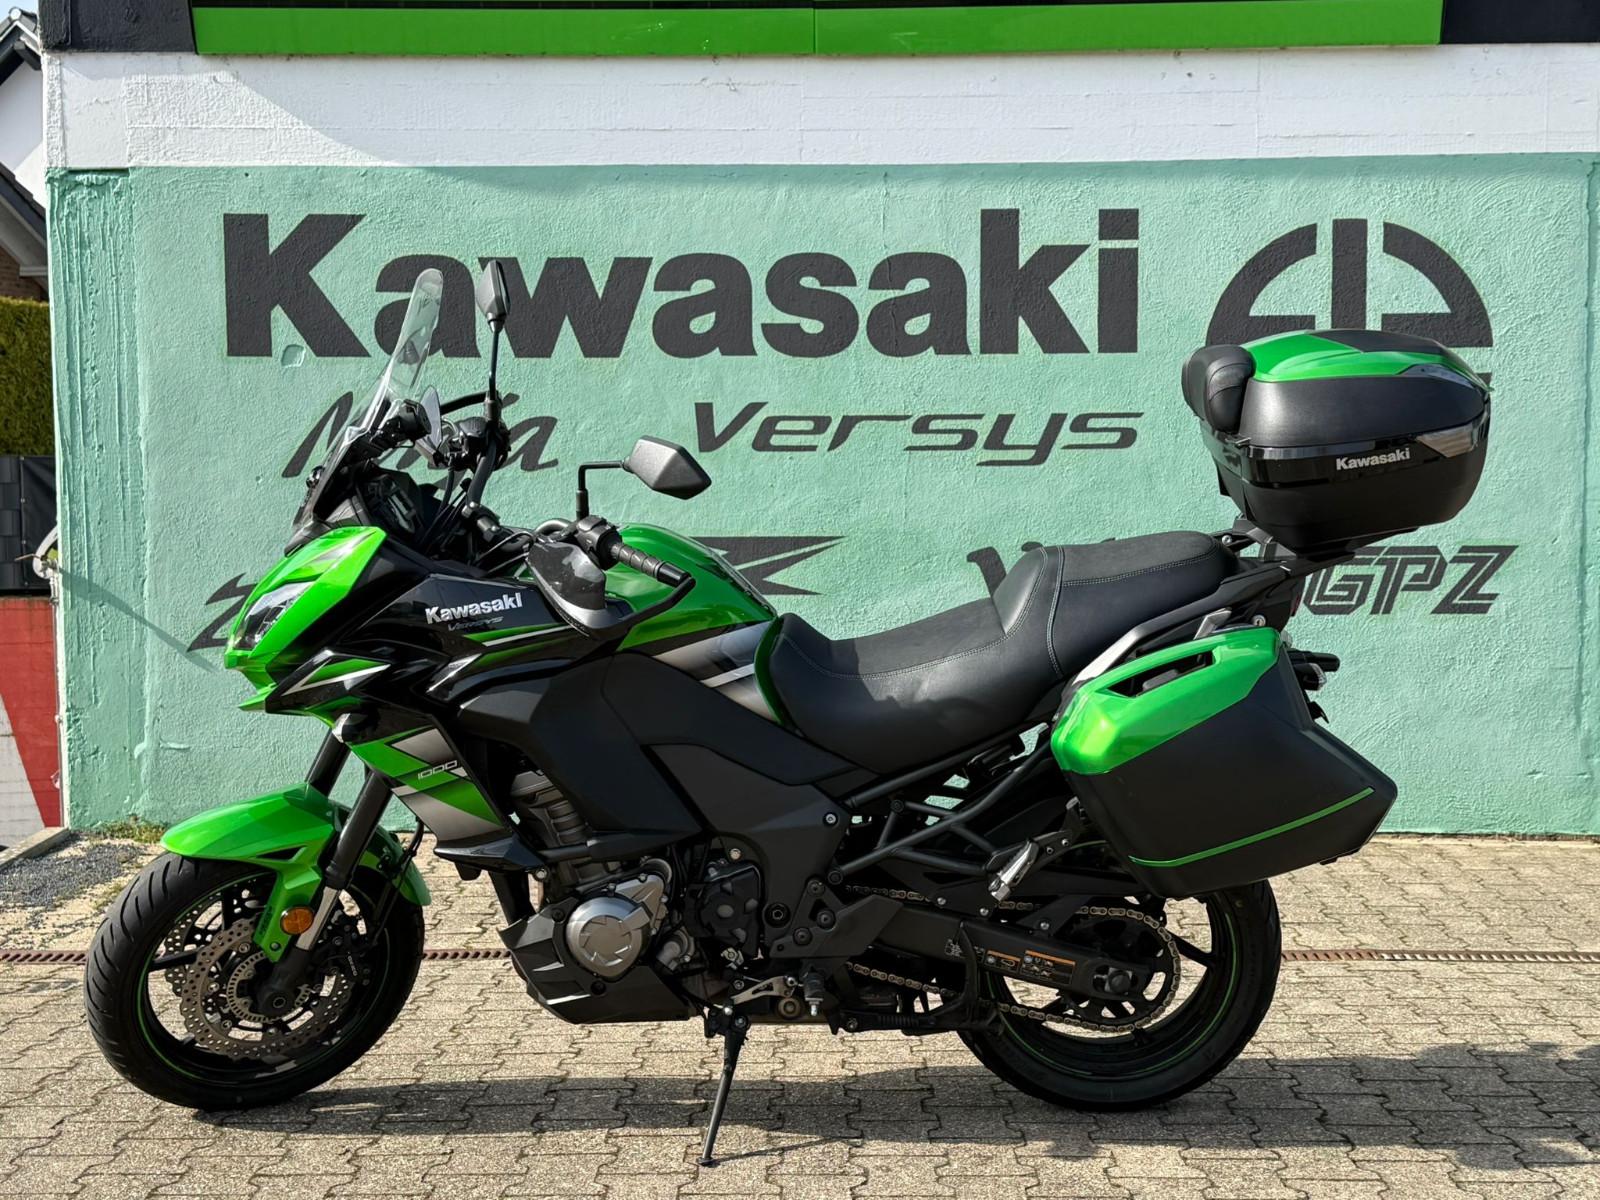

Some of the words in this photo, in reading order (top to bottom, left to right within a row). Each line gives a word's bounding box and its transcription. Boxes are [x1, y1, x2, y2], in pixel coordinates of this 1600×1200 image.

[223, 208, 1139, 358] Kawasaki
[694, 401, 1144, 466] Versys
[1335, 447, 1411, 471] Kawasaki
[1303, 544, 1519, 615] GPZ
[425, 592, 523, 625] Kawasaki
[417, 759, 458, 780] 1000
